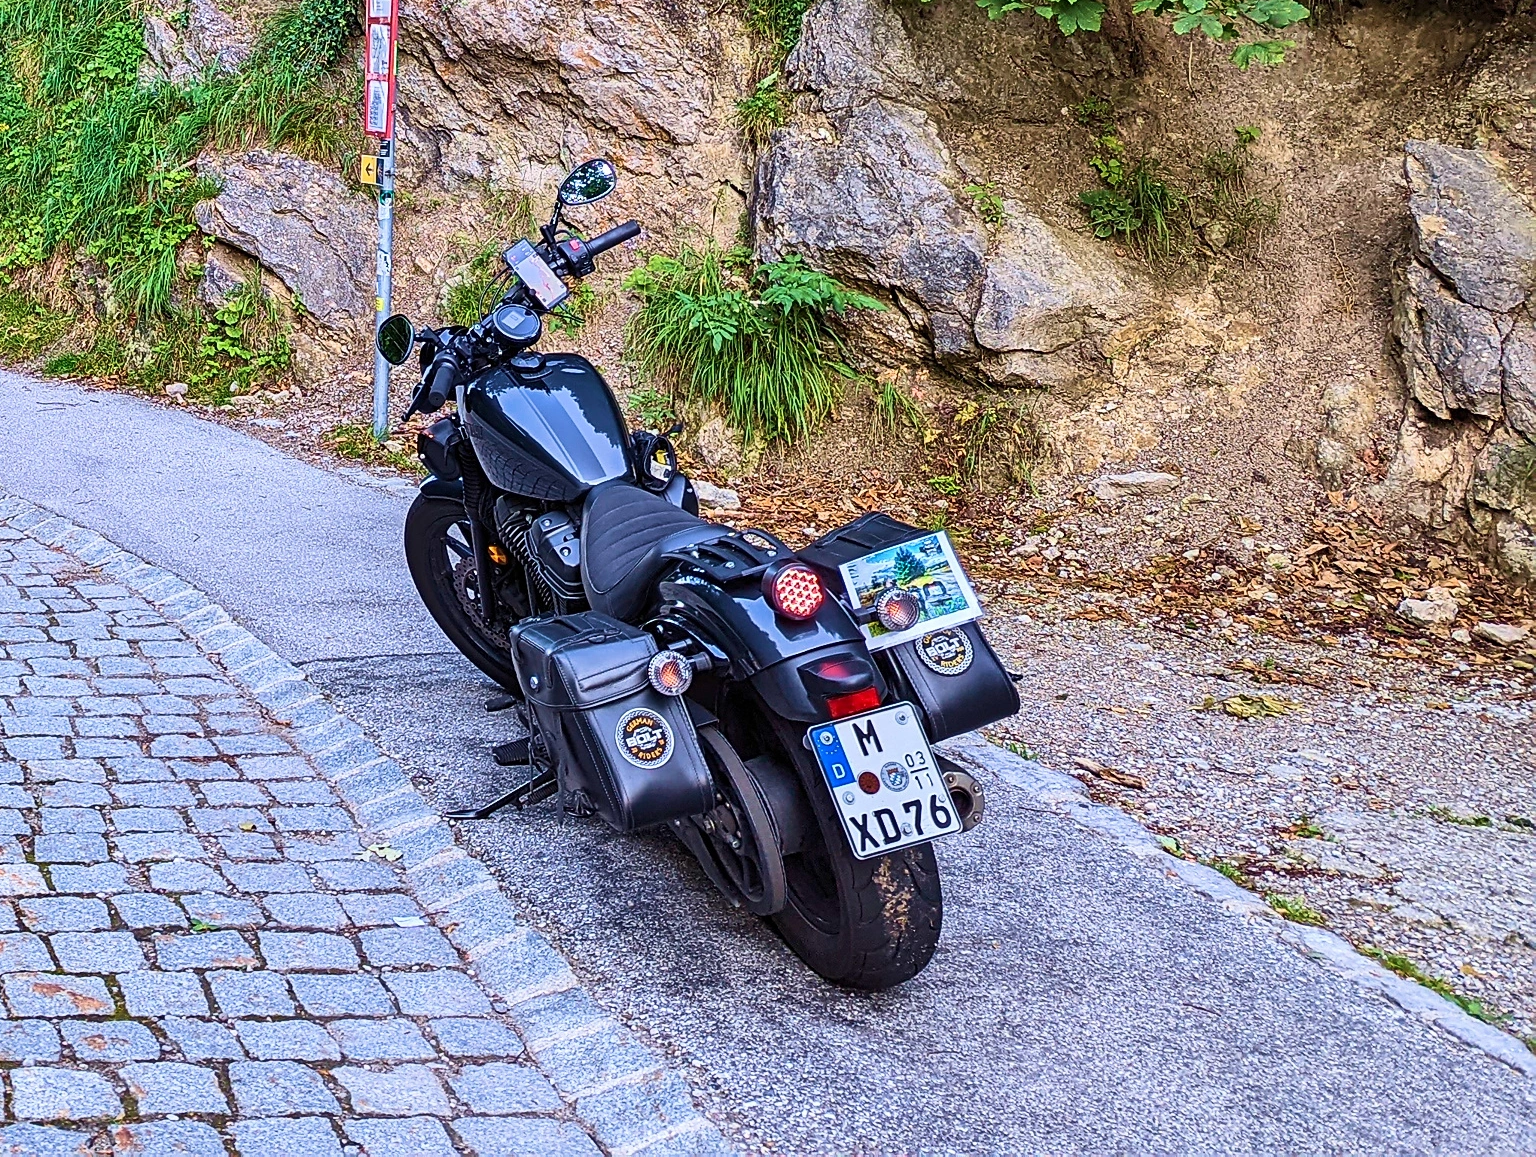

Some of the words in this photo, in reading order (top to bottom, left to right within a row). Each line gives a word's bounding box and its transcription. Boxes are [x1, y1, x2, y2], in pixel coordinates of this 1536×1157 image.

[925, 637, 960, 658] BOLT
[626, 717, 654, 732] GERMAN
[625, 728, 663, 748] BOLT
[851, 719, 884, 757] M
[637, 746, 663, 760] RIDERS
[904, 750, 926, 768] 03
[831, 763, 847, 780] D
[914, 772, 934, 790] 11
